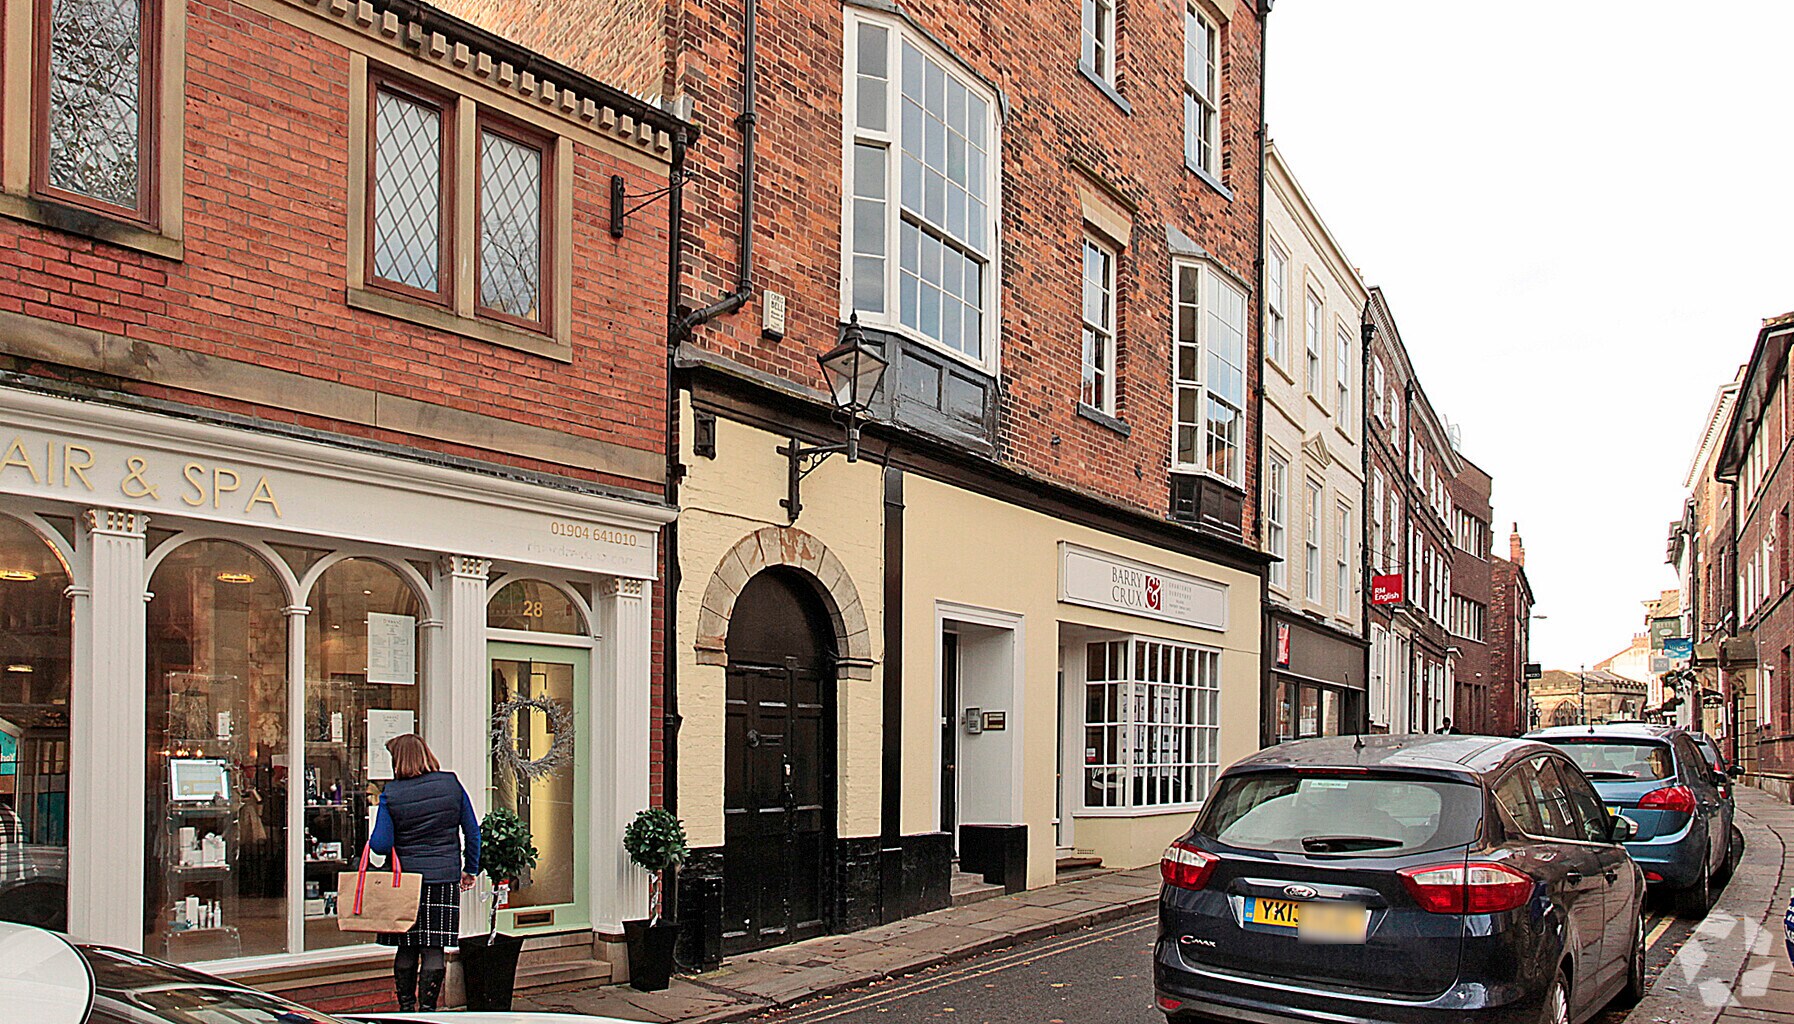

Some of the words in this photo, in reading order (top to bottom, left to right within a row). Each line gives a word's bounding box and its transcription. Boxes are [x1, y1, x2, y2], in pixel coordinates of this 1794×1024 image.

[121, 454, 161, 501] &
[182, 461, 283, 520] SPA
[551, 521, 590, 540] 01904
[592, 528, 638, 547] 641010
[1112, 566, 1142, 587] BARRY
[1111, 585, 1142, 607] CRUX
[1374, 592, 1399, 601] English
[523, 600, 543, 618] 28
